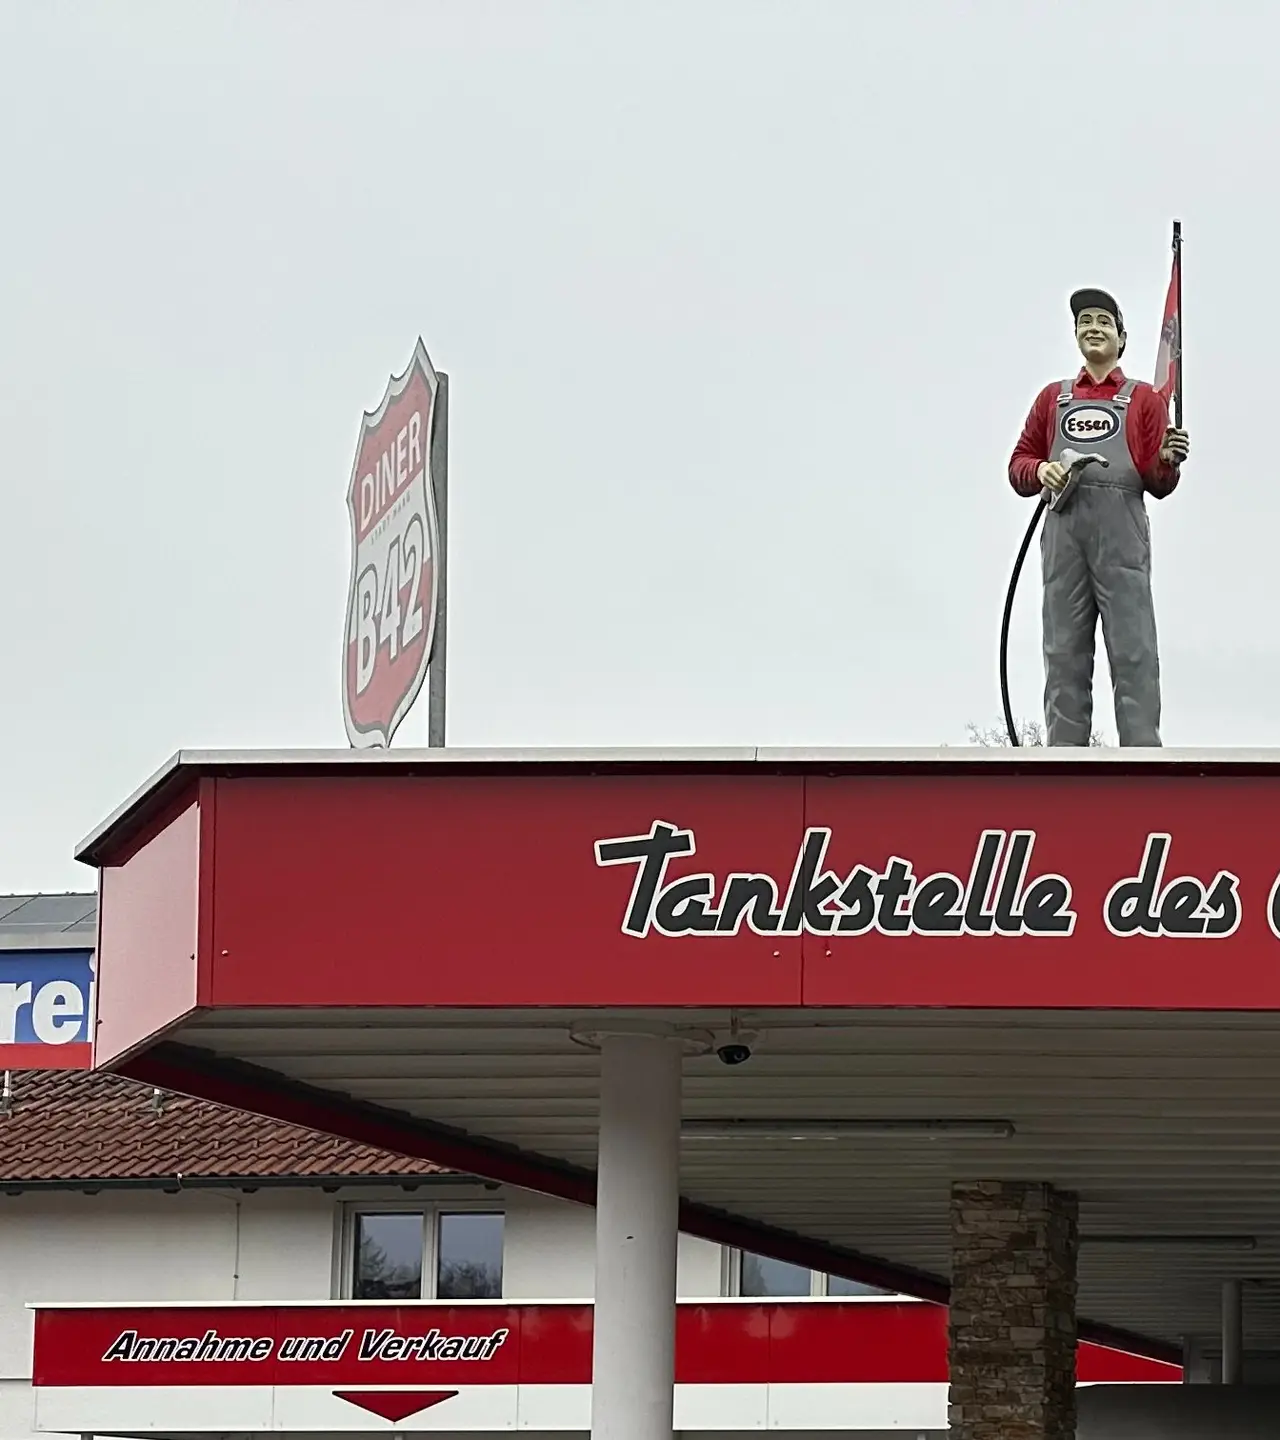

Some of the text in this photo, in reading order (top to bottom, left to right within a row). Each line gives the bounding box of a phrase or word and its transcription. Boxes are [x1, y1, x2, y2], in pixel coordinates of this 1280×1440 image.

[360, 410, 422, 532] DINER
[1067, 417, 1112, 432] Essen
[356, 512, 424, 696] B42
[594, 819, 1077, 938] Tankstelle
[1103, 832, 1242, 938] des
[102, 1328, 509, 1362] Annahme und Verkauf
